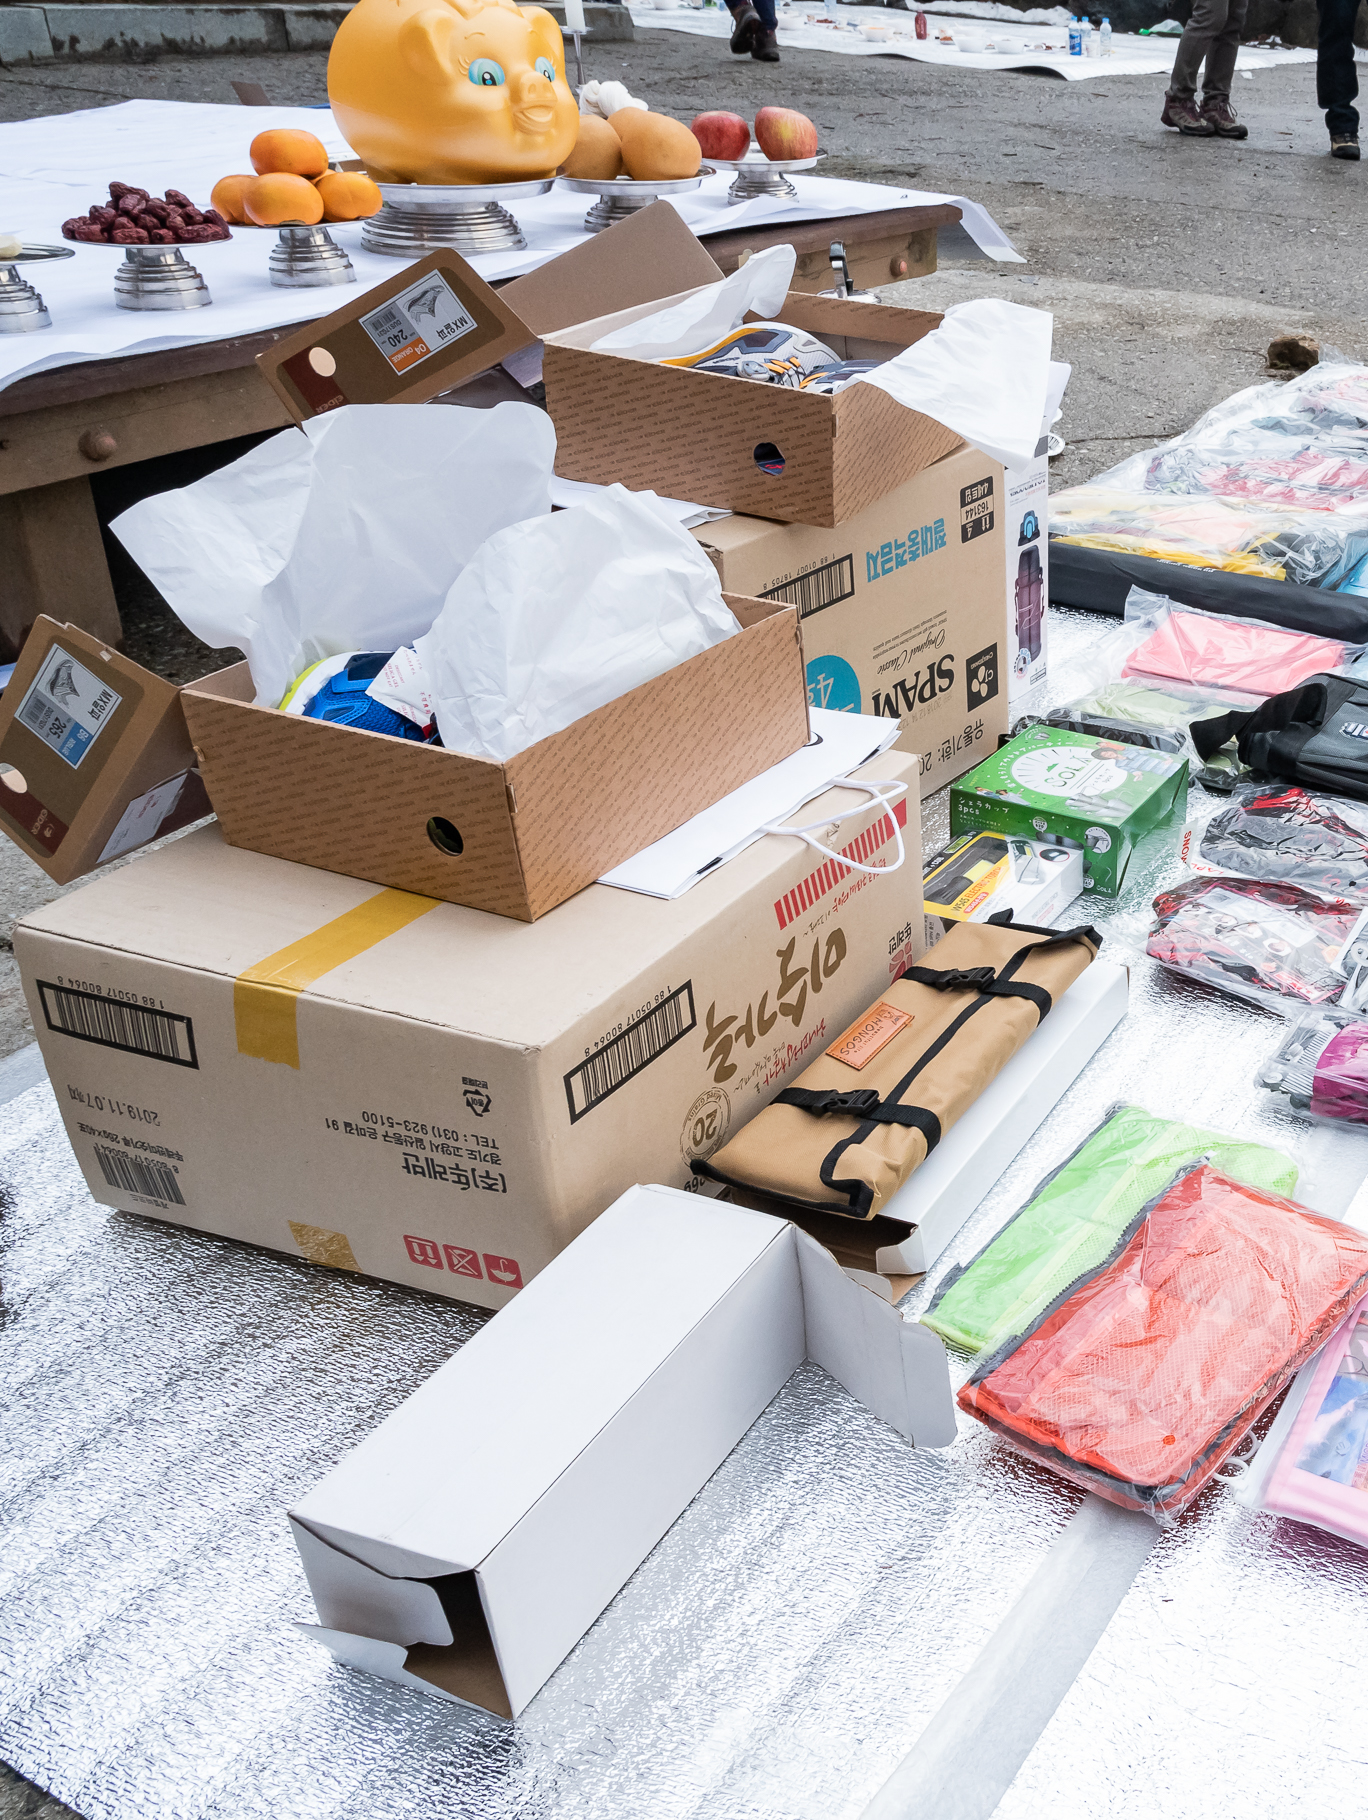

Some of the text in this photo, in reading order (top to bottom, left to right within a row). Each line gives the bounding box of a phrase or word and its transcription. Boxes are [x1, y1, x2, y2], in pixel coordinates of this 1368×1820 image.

[387, 329, 408, 348] 240
[391, 346, 413, 363] ORANGE
[965, 501, 989, 520] 163144
[819, 556, 829, 566] 88
[865, 518, 947, 582] 절대충격금지
[877, 650, 907, 675] Classic
[908, 629, 945, 663] Original
[871, 654, 955, 720] SPAM
[982, 668, 995, 683] CJ
[48, 717, 68, 739] 265
[958, 805, 980, 815] 3pcs
[57, 976, 164, 1009] 1 88 05017 80064 8
[702, 928, 848, 1084] 미숫가루
[583, 985, 673, 1057] 1 88 05017 80064 8
[839, 1016, 882, 1057] MONGOS
[324, 1118, 502, 1166] 경기도 고양시 일산동구 은마길 91
[362, 1110, 499, 1150] TEL 031) 923-5100
[691, 1108, 719, 1147] 20
